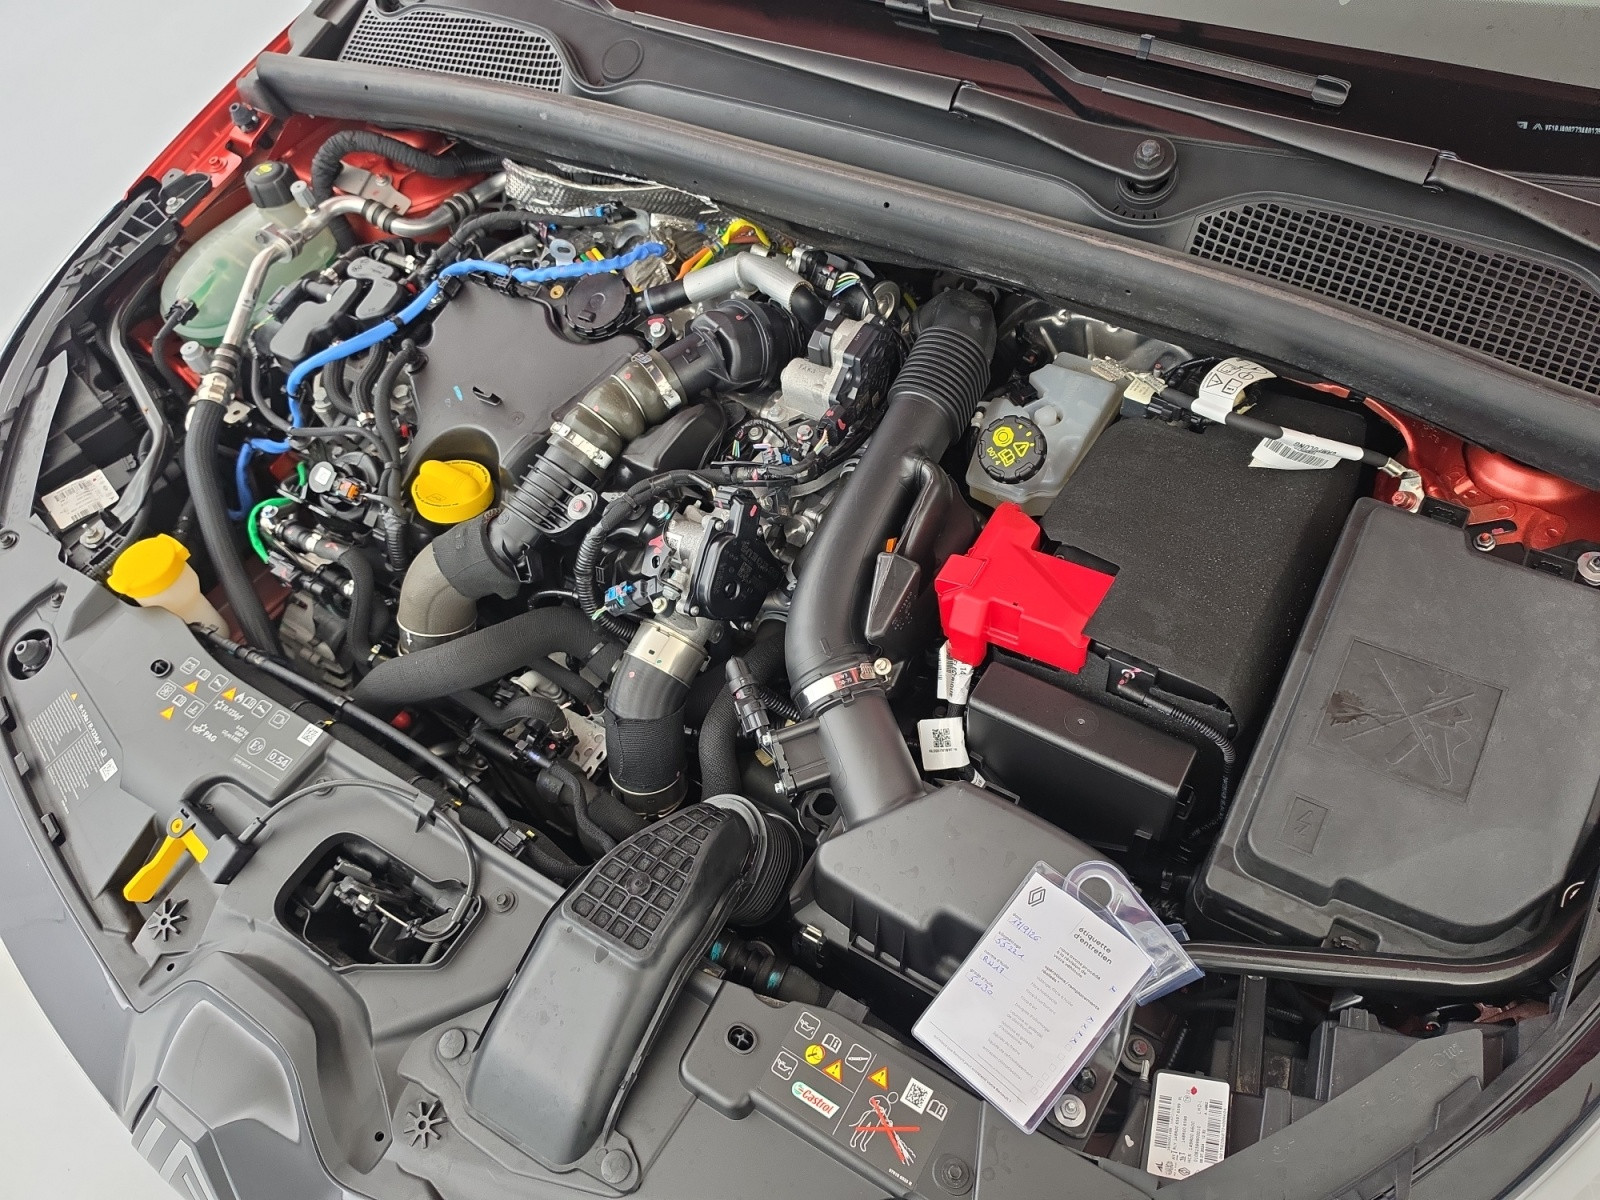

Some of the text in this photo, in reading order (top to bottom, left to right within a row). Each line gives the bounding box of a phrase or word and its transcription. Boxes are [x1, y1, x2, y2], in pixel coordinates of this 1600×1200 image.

[986, 446, 999, 460] DOT
[202, 729, 218, 743] PAG
[268, 750, 289, 768] 0,54
[1072, 931, 1113, 965] d'entretien
[1077, 925, 1112, 955] étiquette
[802, 1088, 834, 1115] Castrol
